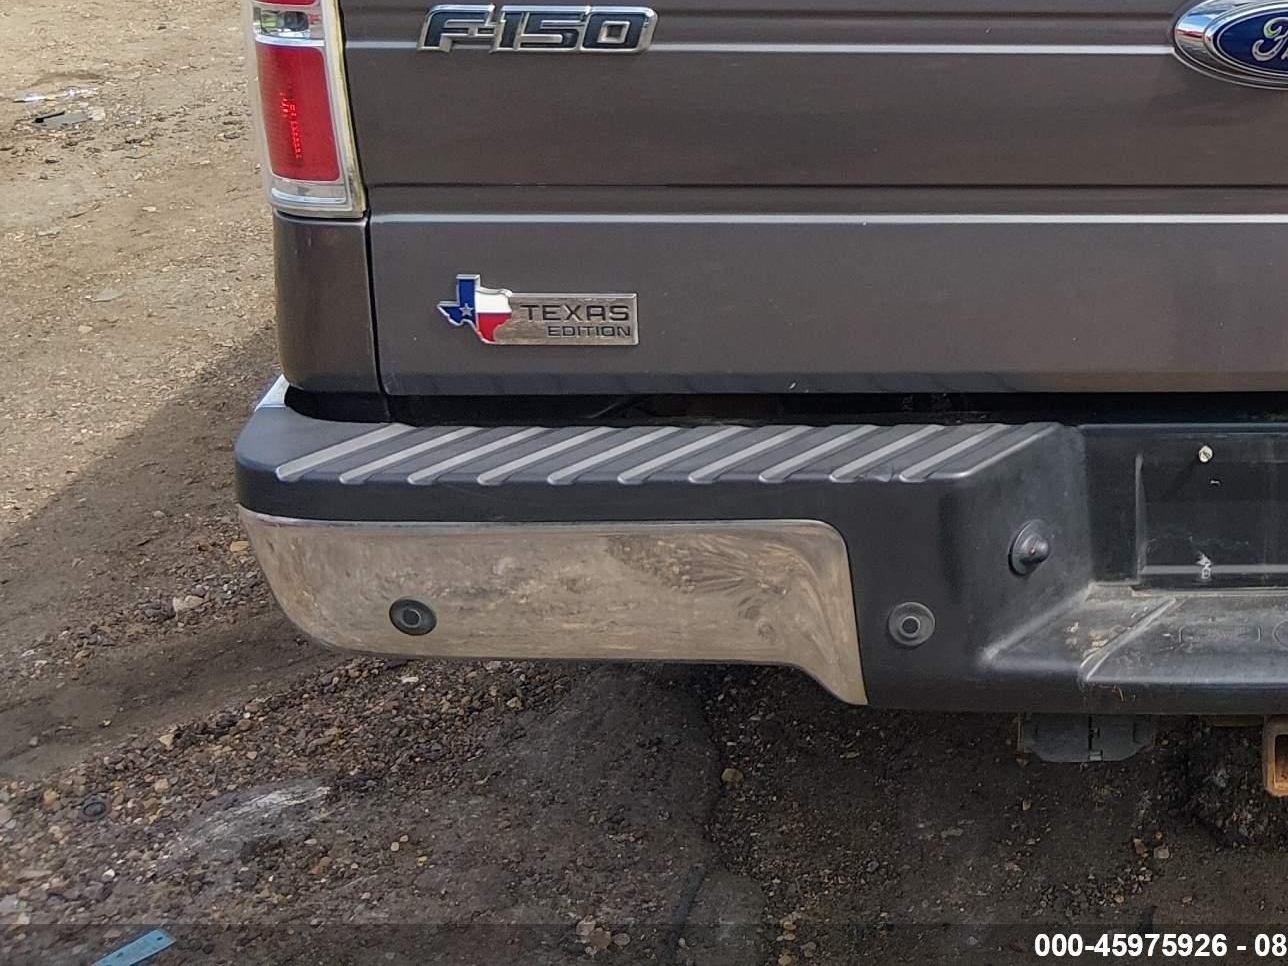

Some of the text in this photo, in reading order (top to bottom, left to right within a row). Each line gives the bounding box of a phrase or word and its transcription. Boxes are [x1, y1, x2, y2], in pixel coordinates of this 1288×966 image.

[417, 4, 658, 53] F-150
[519, 304, 630, 322] TEXAS
[546, 325, 631, 337] EDITION
